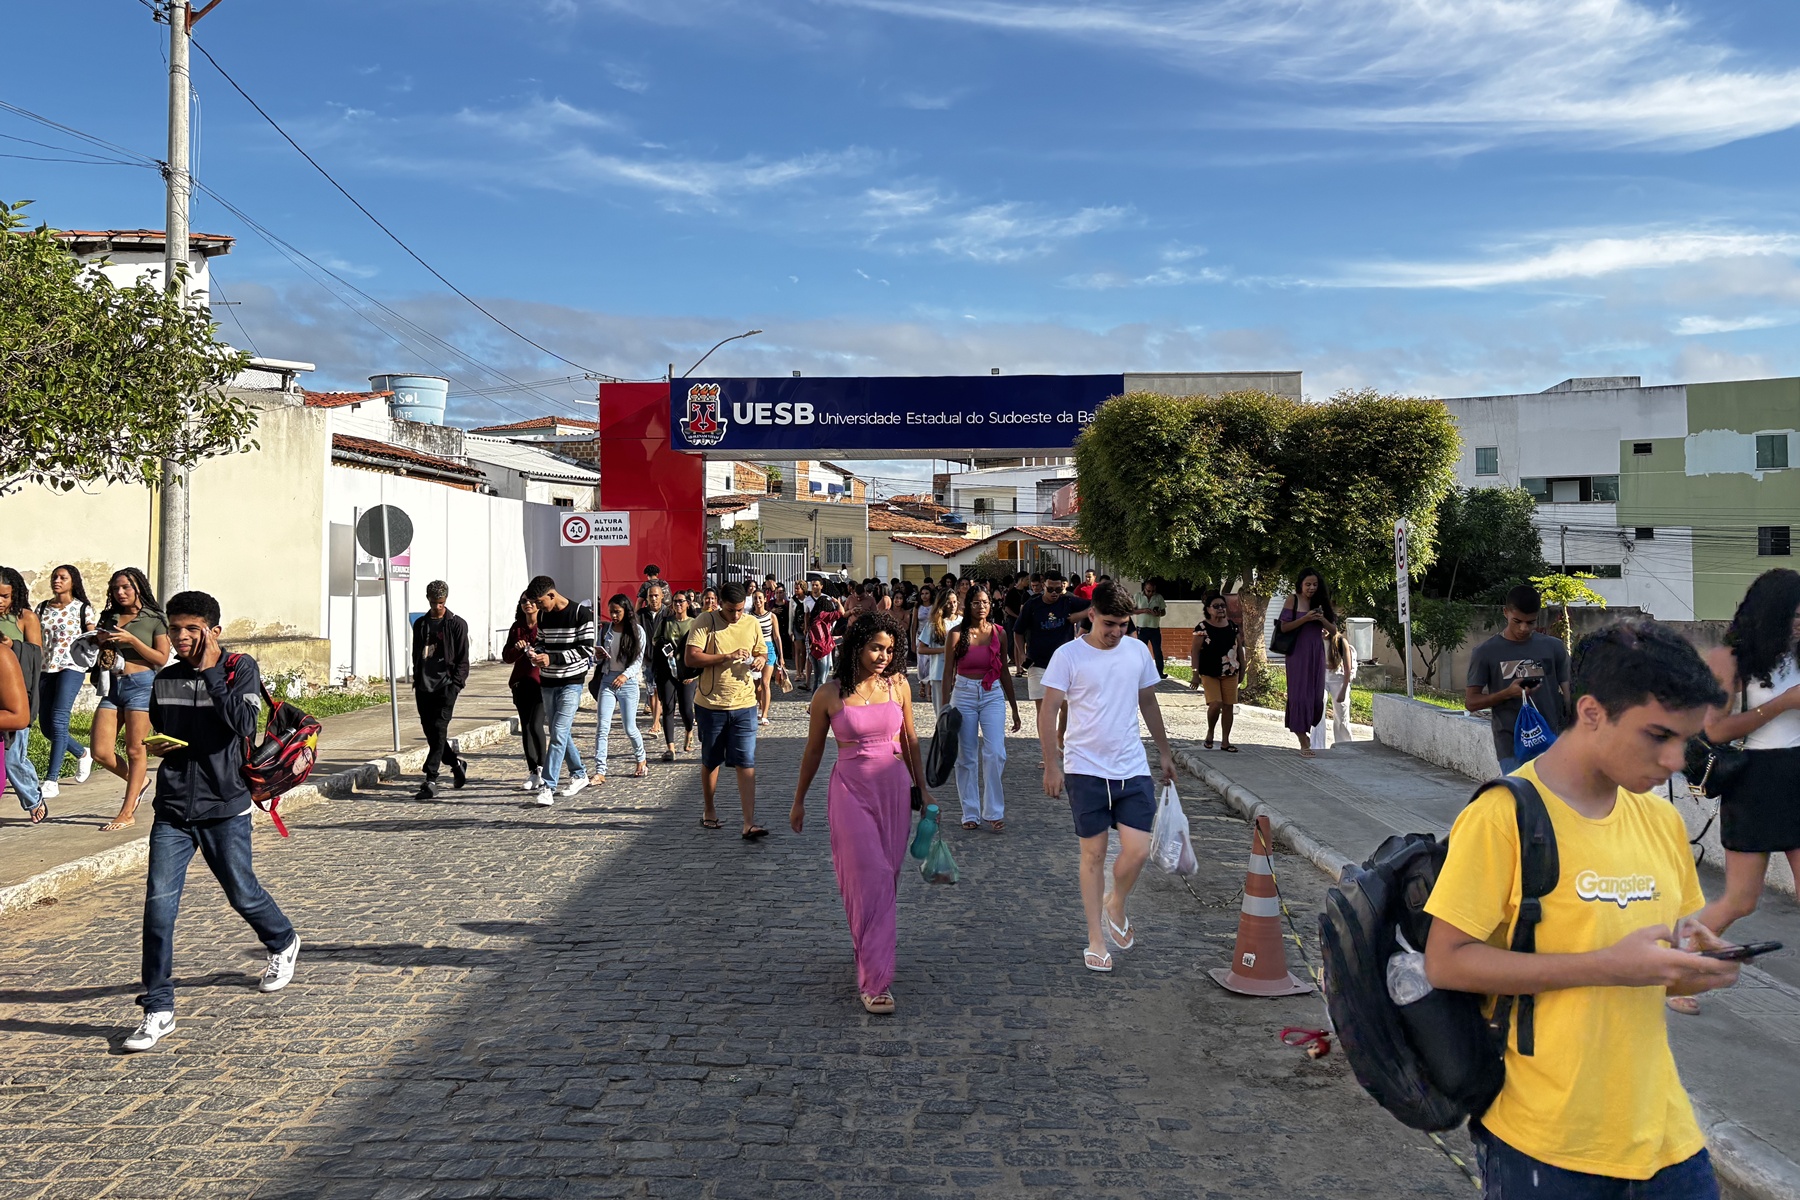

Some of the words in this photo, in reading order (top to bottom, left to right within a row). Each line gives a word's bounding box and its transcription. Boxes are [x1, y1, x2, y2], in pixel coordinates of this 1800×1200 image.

[732, 402, 815, 425] UESB
[818, 411, 901, 425] Universidade
[906, 411, 962, 425] Estadual
[965, 411, 984, 425] do
[988, 411, 1052, 425] Sudoeste
[1056, 410, 1073, 423] da
[1077, 410, 1096, 423] Ba
[1576, 870, 1653, 904] Gangster
